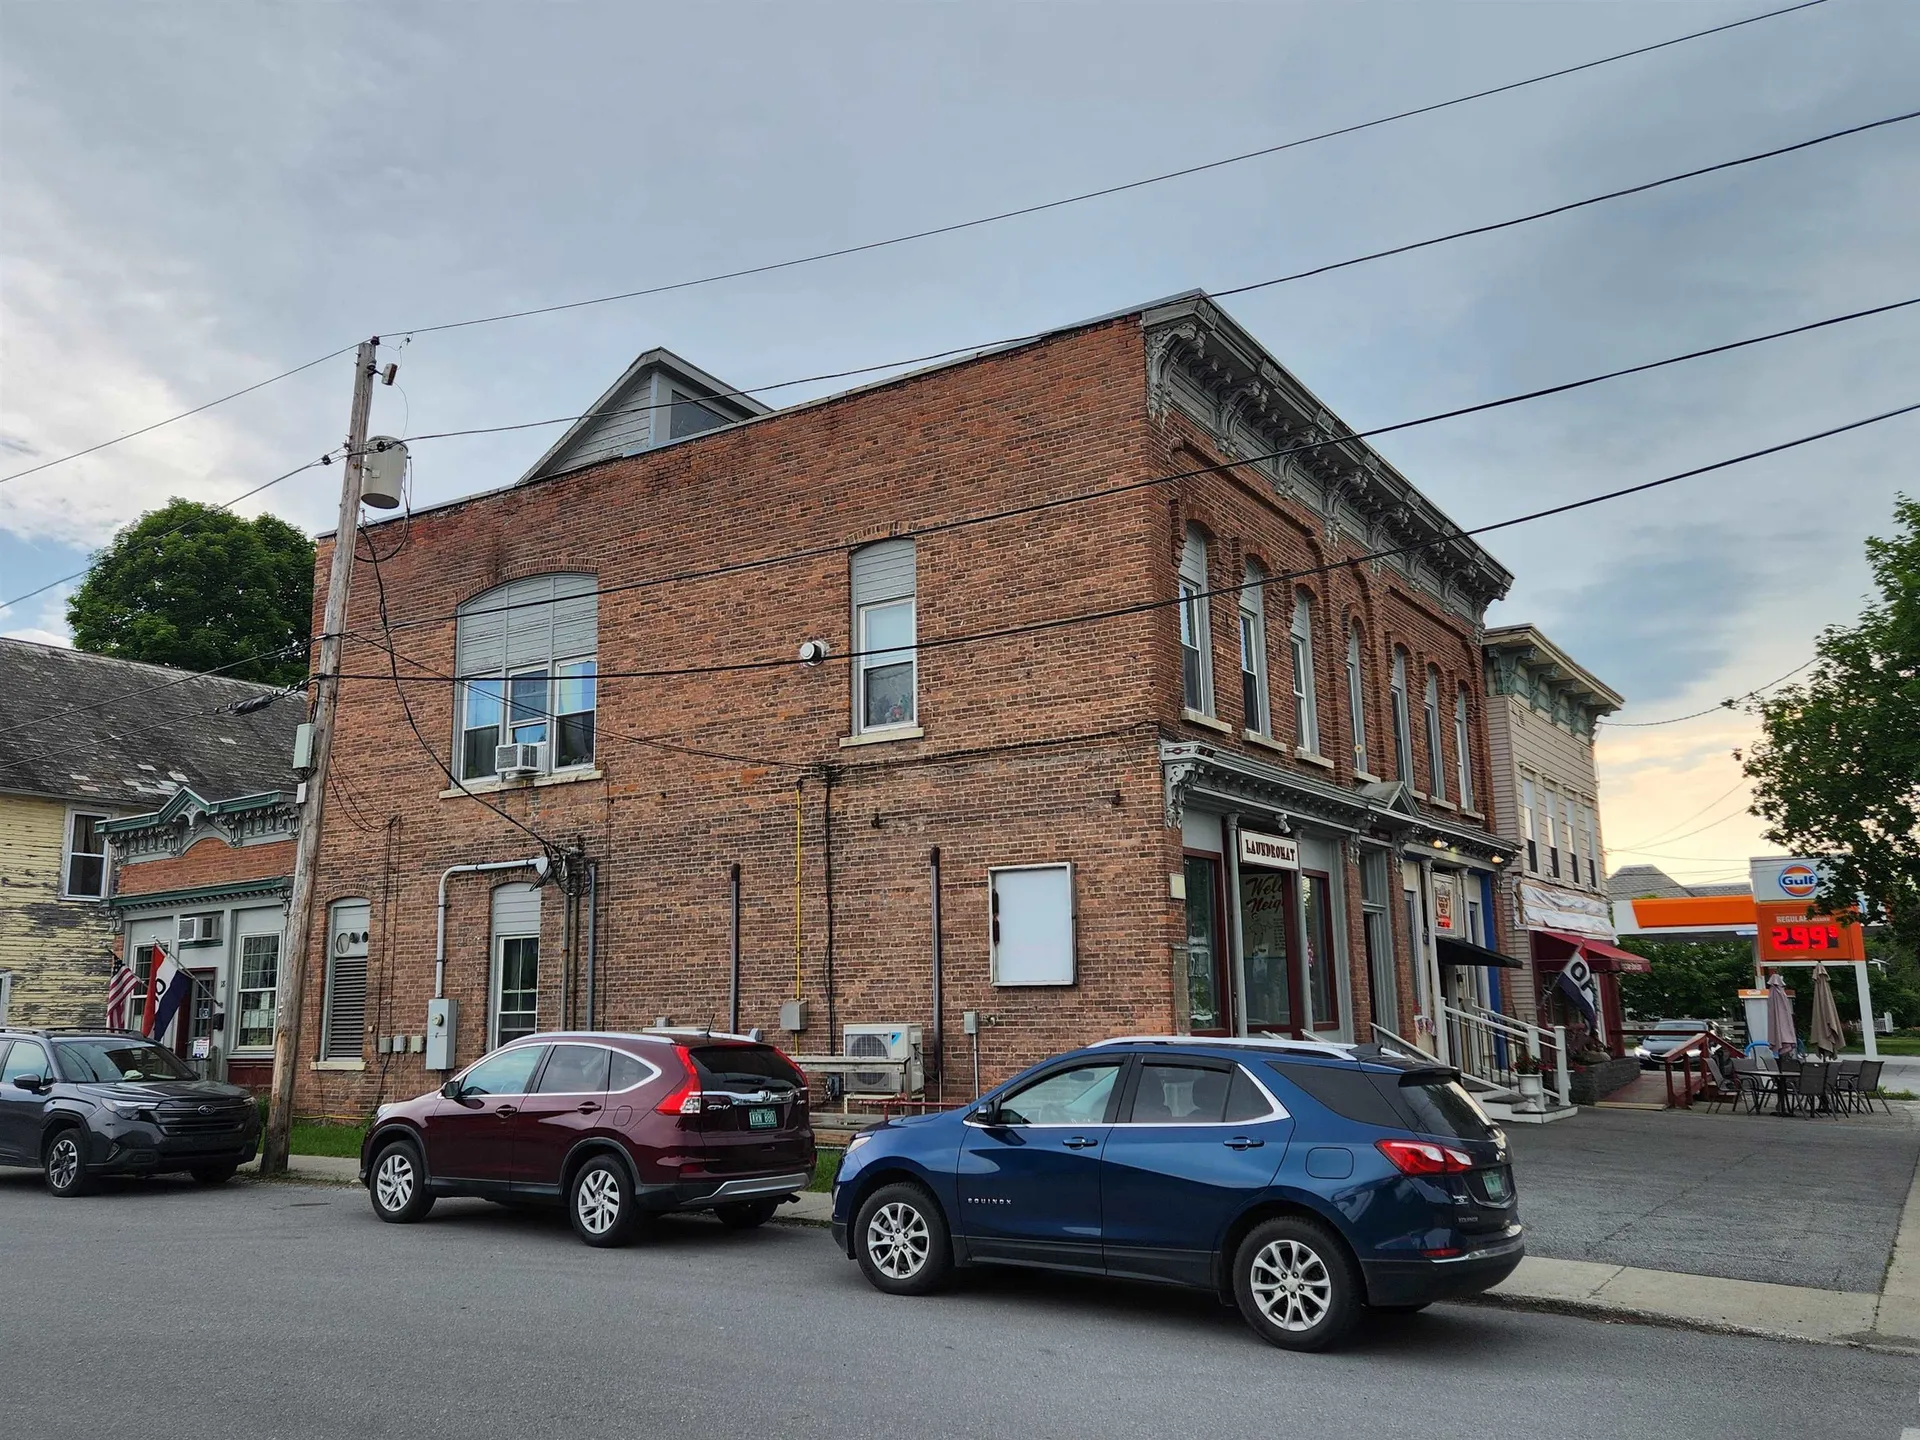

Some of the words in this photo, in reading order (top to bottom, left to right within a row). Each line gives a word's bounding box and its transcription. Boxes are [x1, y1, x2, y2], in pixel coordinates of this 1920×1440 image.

[1245, 839, 1296, 862] LAUNDROMAT
[1782, 875, 1815, 885] Gulf
[967, 1197, 1012, 1205] EQUINOX
